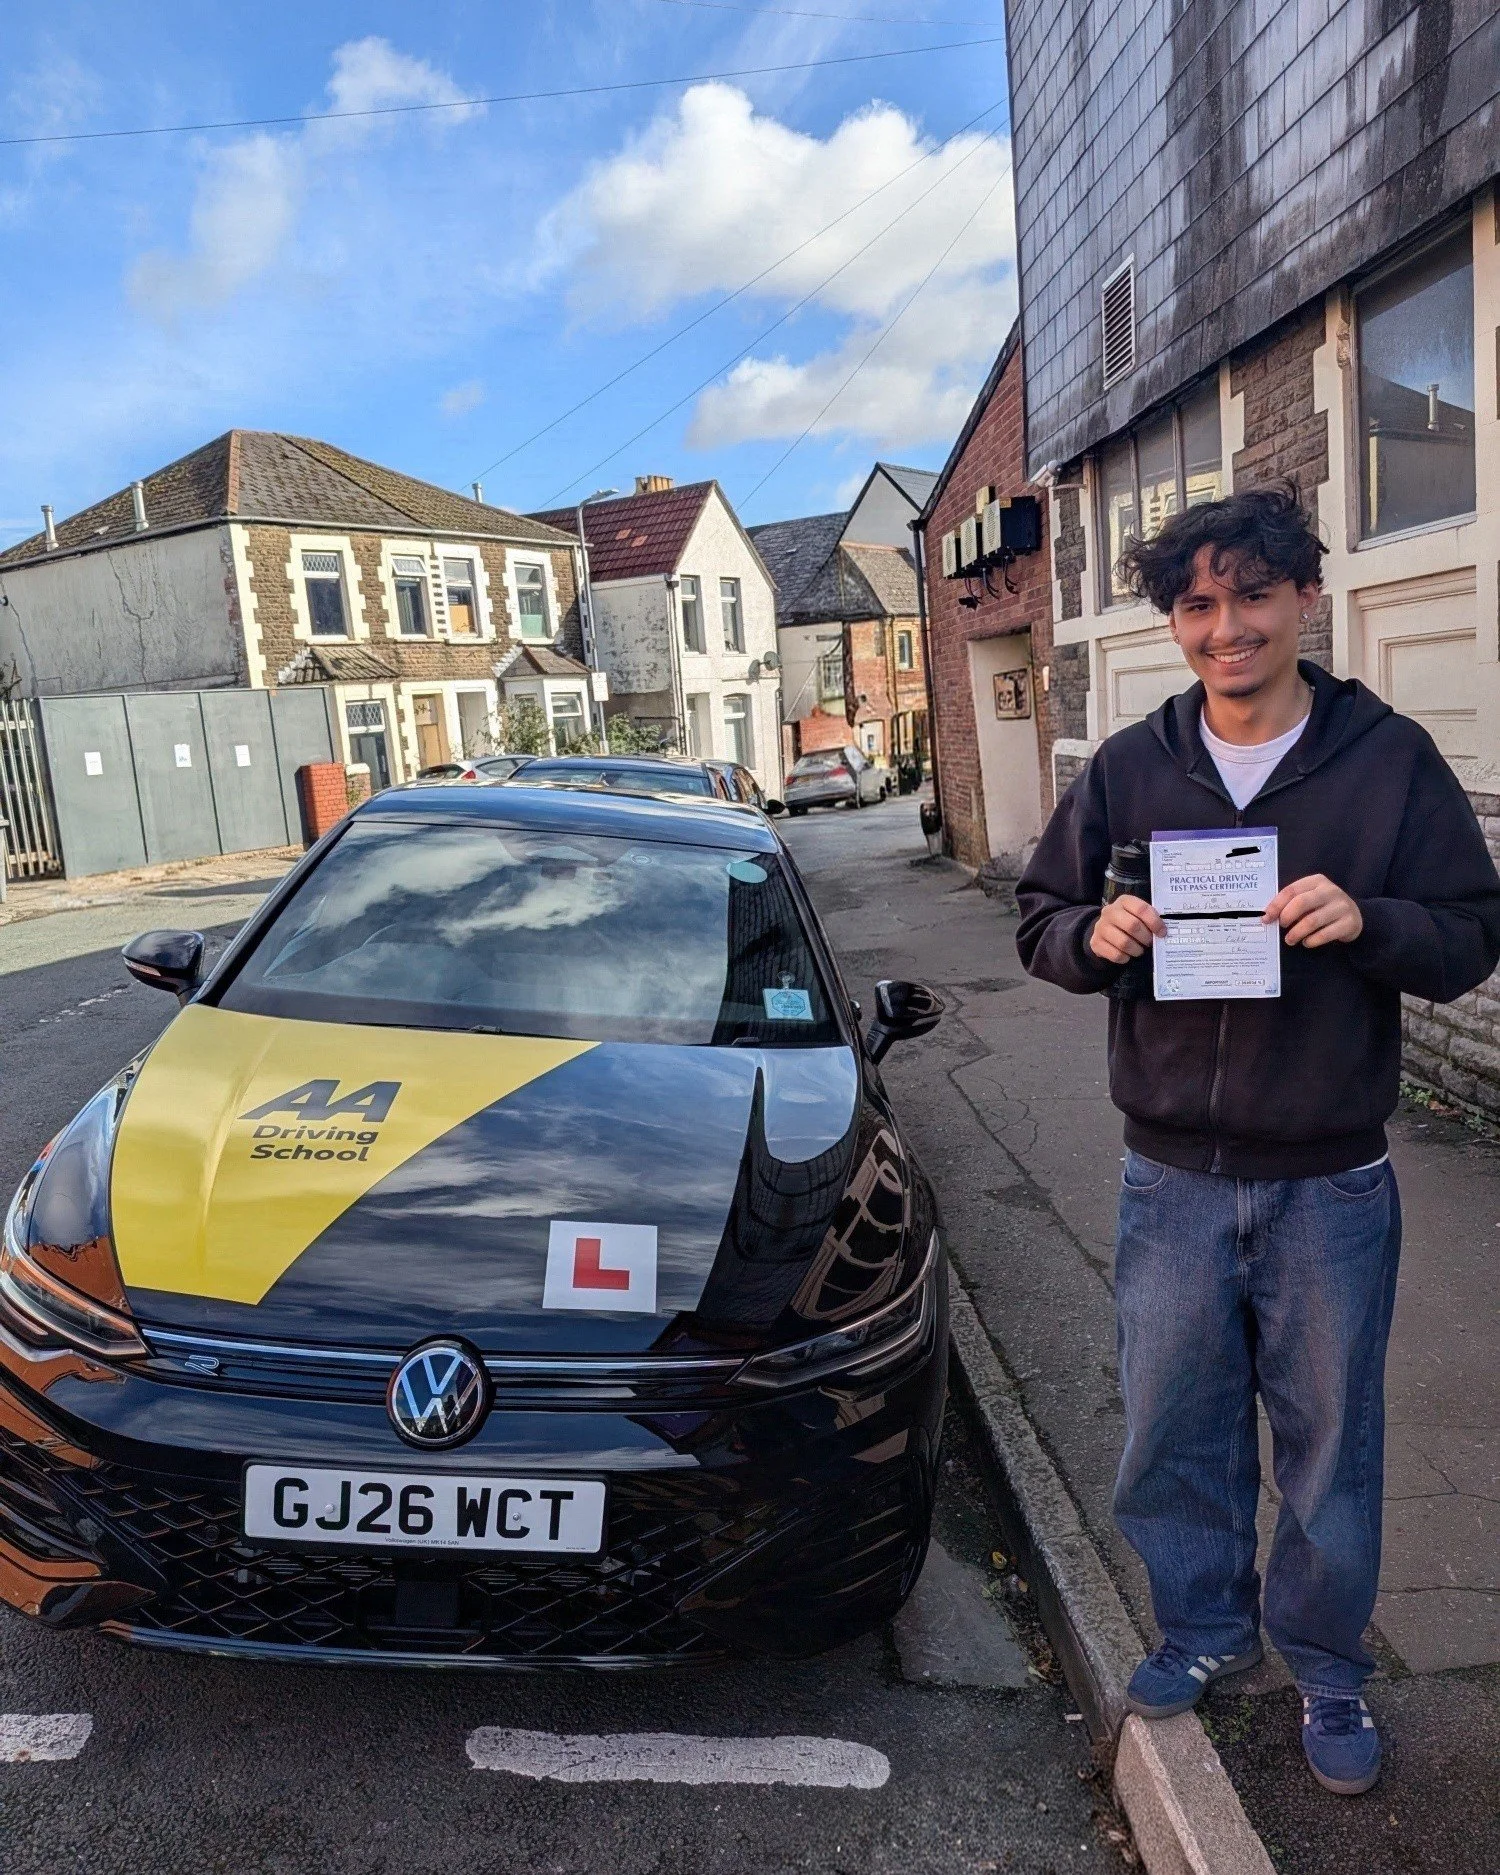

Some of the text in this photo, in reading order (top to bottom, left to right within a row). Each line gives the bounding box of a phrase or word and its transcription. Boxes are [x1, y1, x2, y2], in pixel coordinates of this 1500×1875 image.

[1169, 873, 1258, 884] PRACTICAL DRIVING
[1189, 883, 1208, 891] PASS
[1209, 881, 1258, 890] CERTIFICATE
[237, 1079, 402, 1122] AA
[252, 1125, 379, 1144] Driving
[250, 1144, 368, 1162] School
[572, 1237, 630, 1290] L
[272, 1476, 574, 1541] GJ26 WCT
